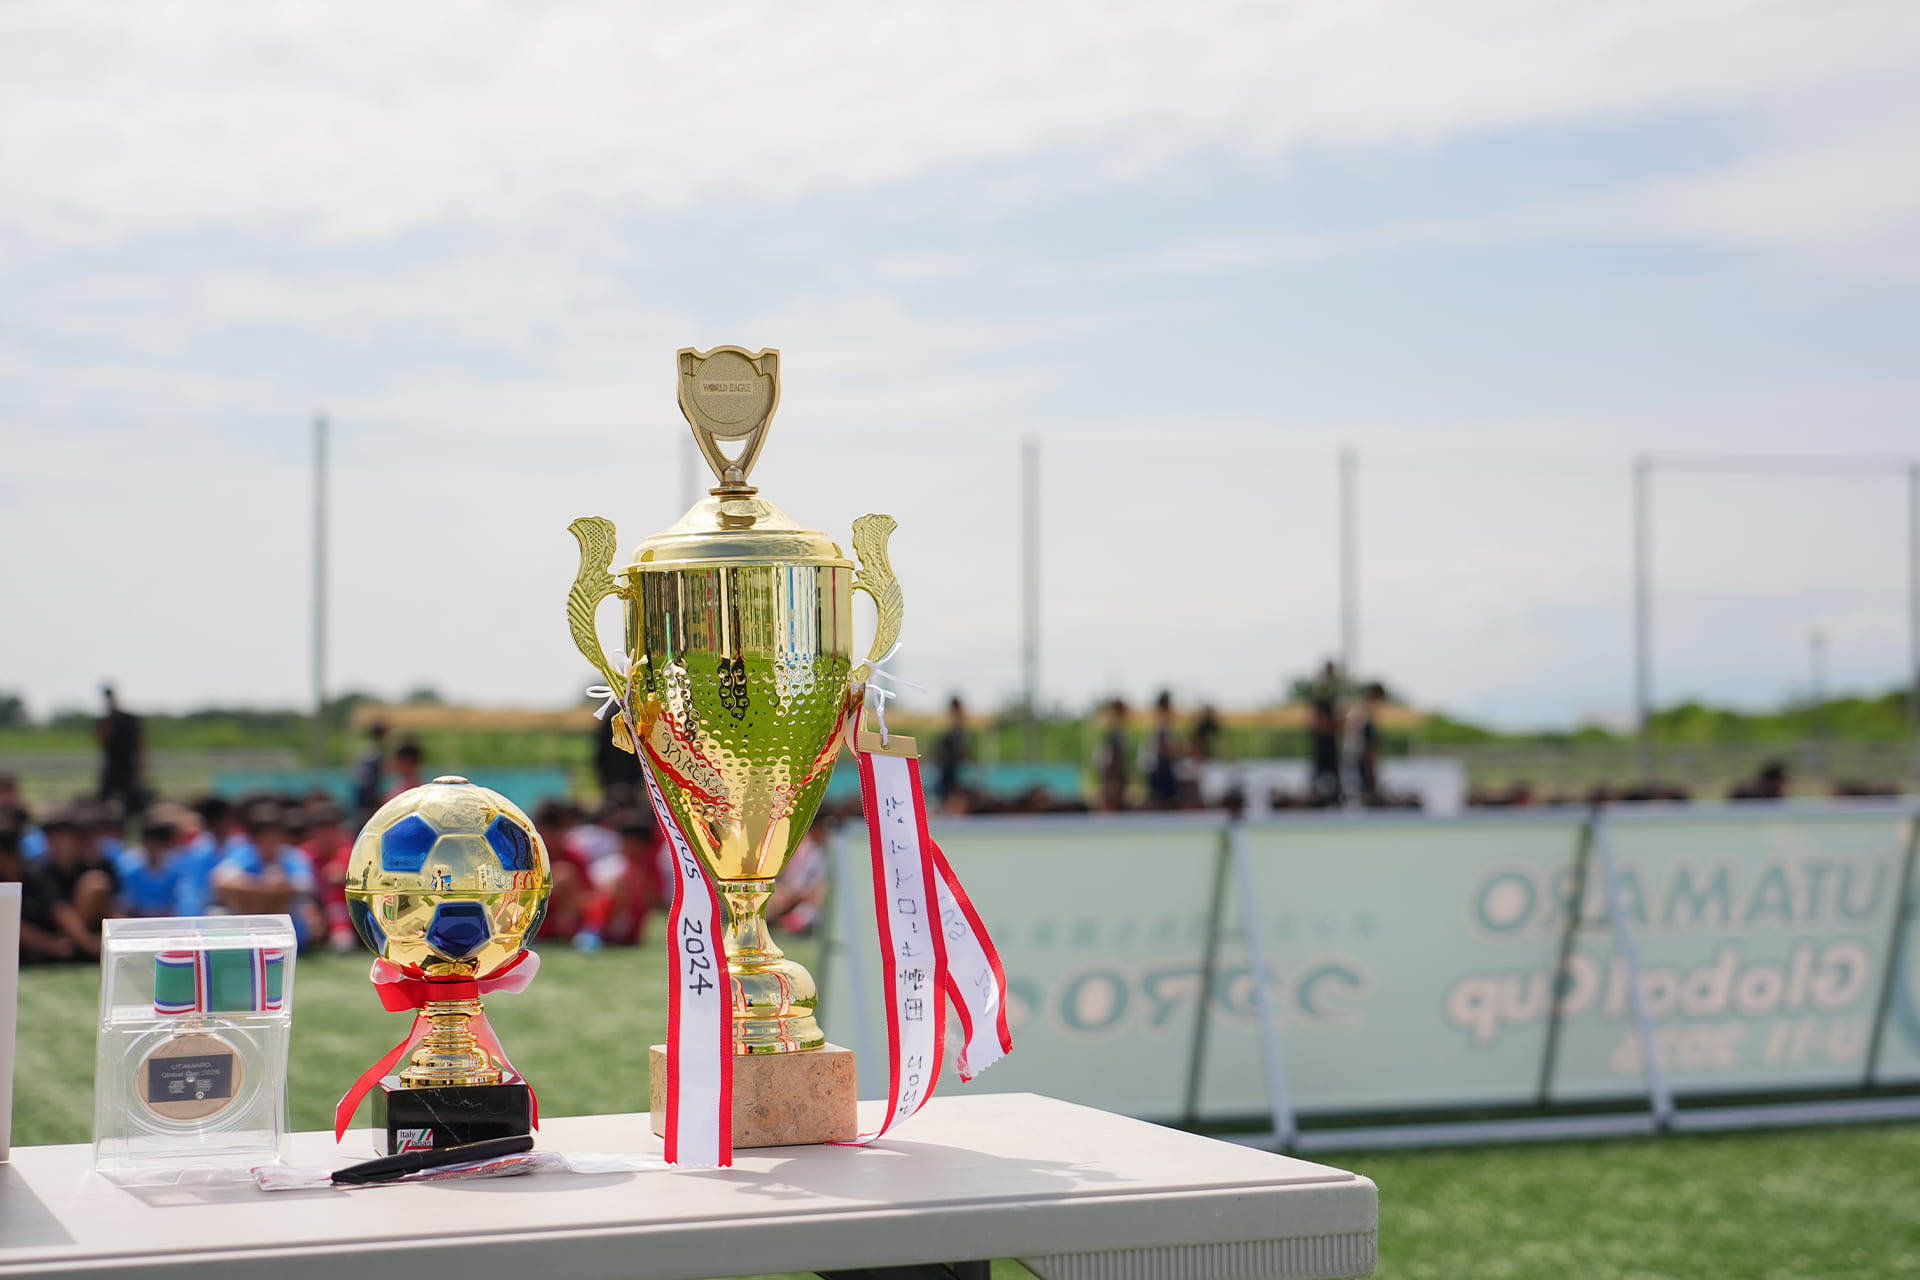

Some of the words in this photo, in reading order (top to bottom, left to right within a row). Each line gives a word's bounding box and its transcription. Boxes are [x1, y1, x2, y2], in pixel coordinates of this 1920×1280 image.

[703, 383, 728, 392] WORLD
[729, 383, 751, 392] EAGLE
[684, 917, 713, 996] 2024
[400, 1130, 416, 1139] Italy
